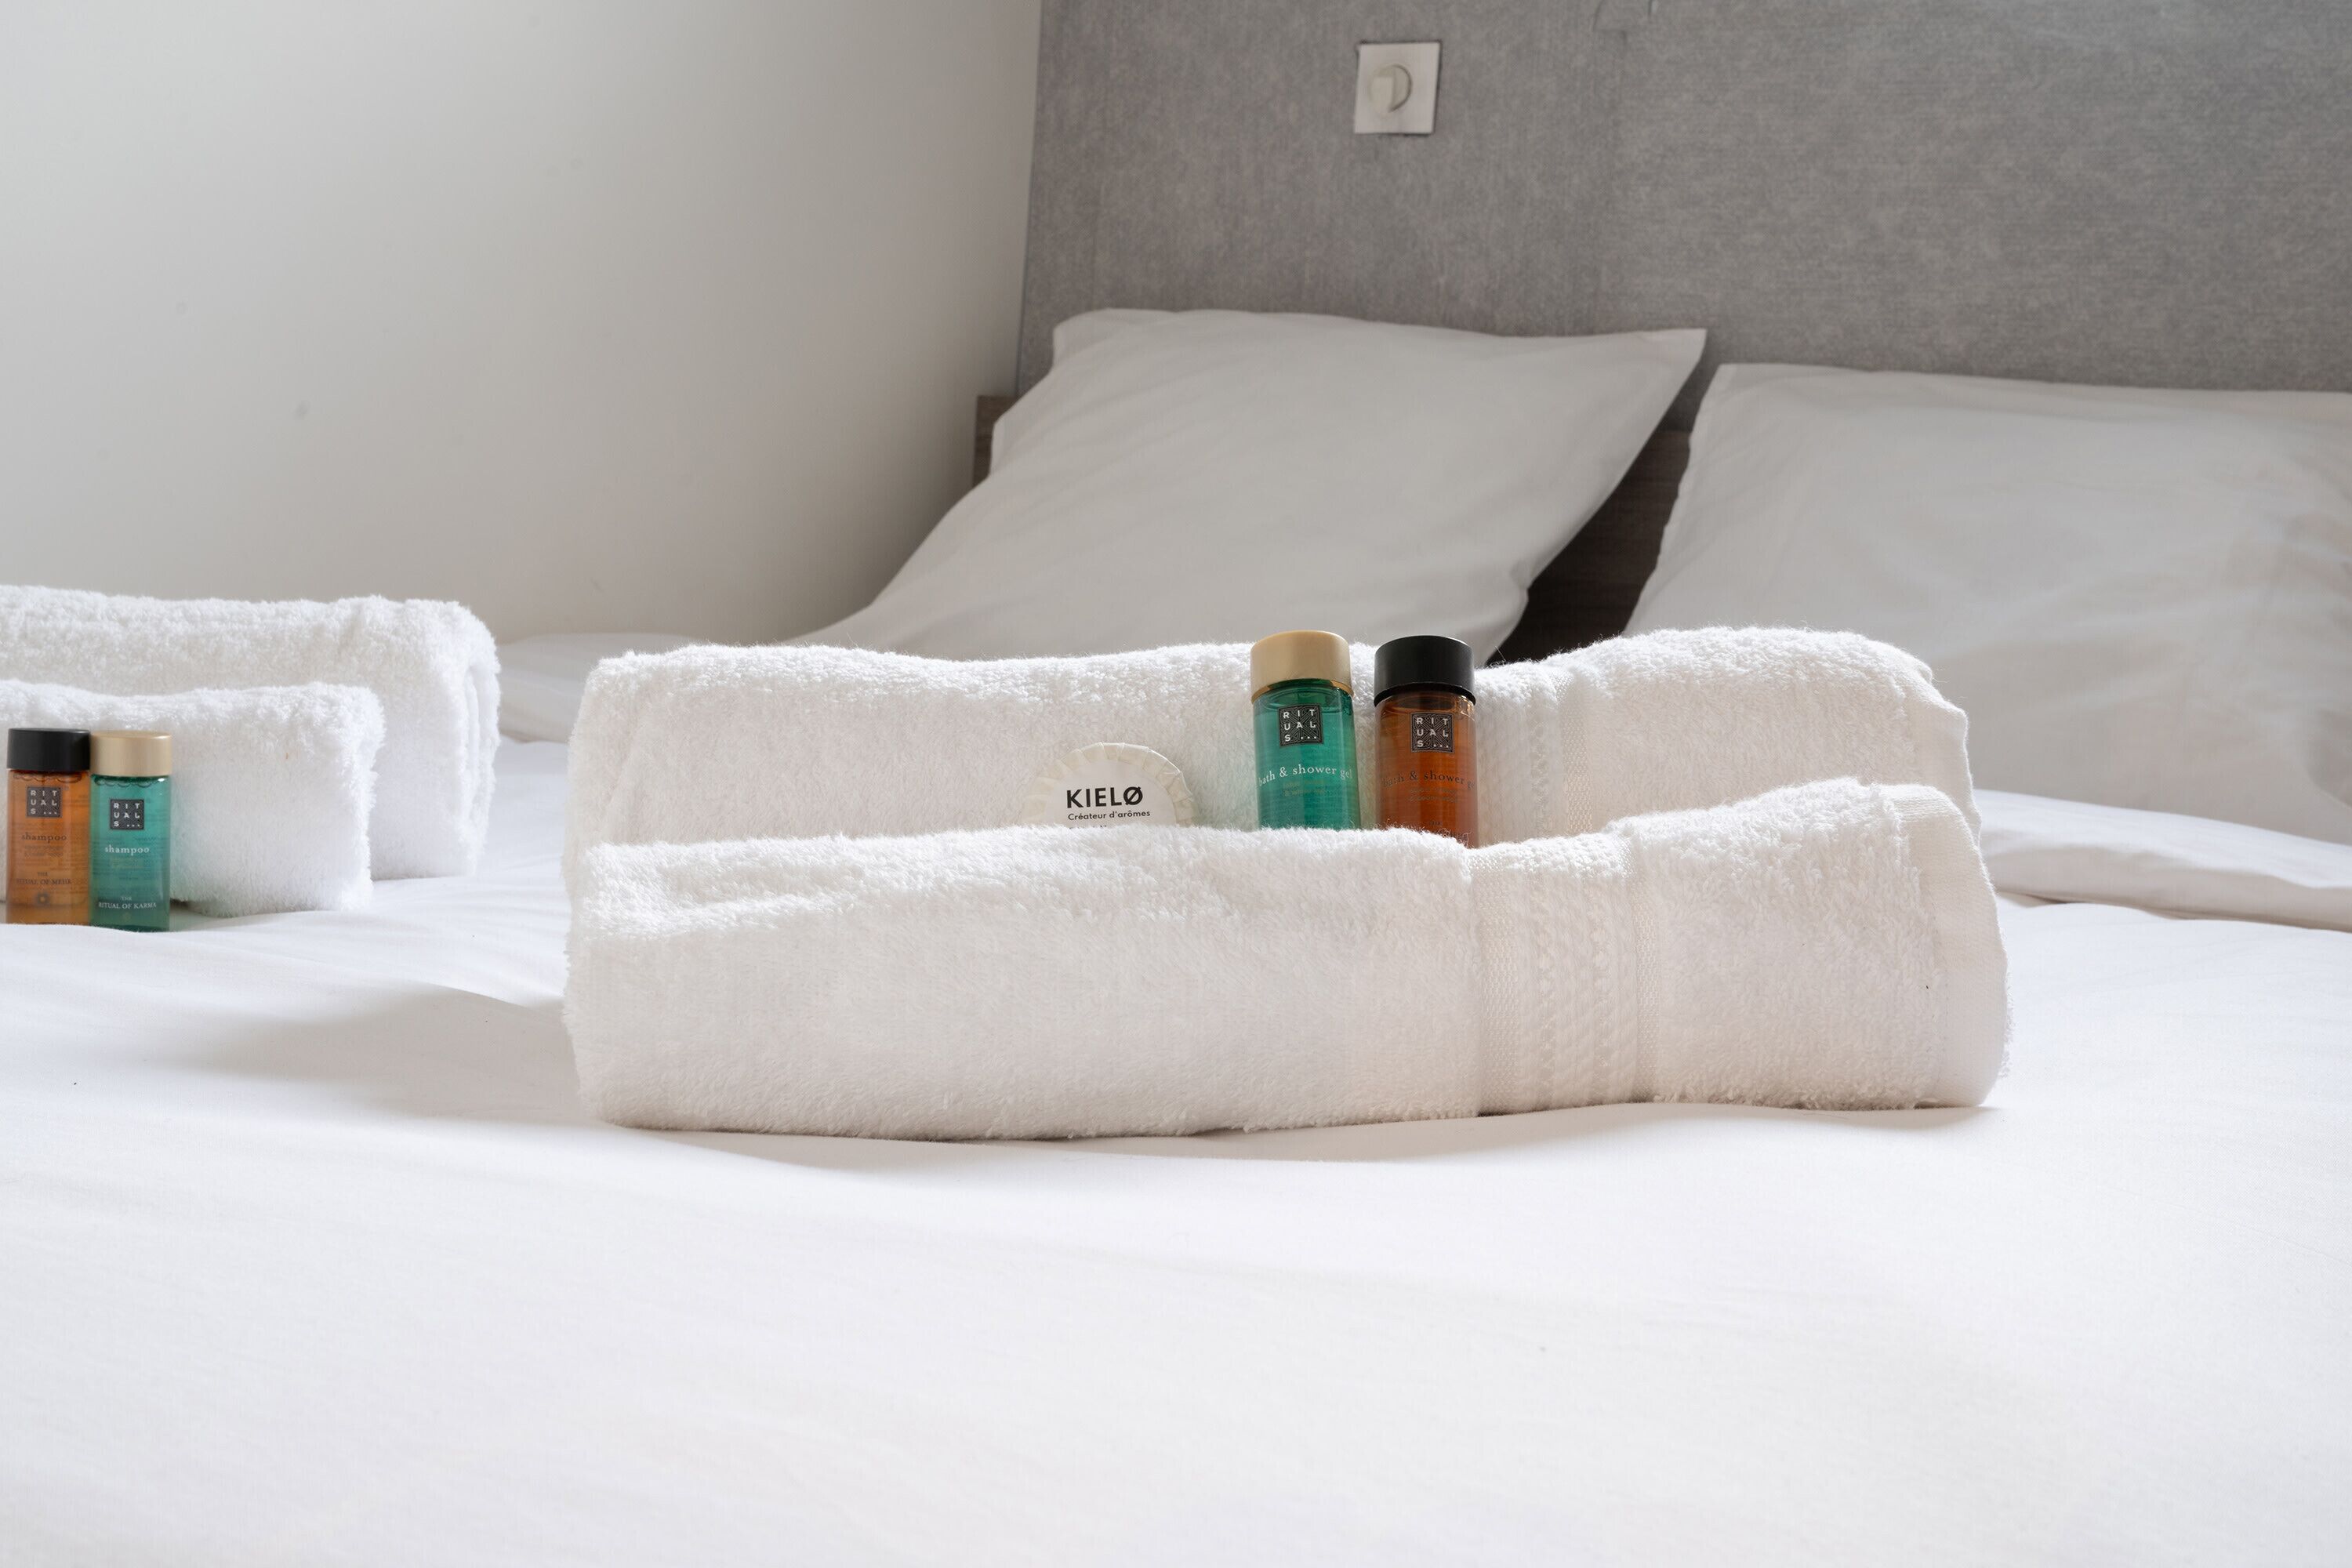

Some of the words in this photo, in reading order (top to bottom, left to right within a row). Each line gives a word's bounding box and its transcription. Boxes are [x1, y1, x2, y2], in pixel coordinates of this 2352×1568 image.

[1258, 771, 1276, 786] bath
[1279, 766, 1289, 778] &
[1293, 764, 1337, 775] shower
[1340, 768, 1352, 780] gel
[1409, 770, 1418, 781] &
[1423, 770, 1465, 784] shower
[1066, 786, 1144, 808] KIELØ
[21, 832, 67, 844] shampoo
[104, 844, 150, 856] shampoo
